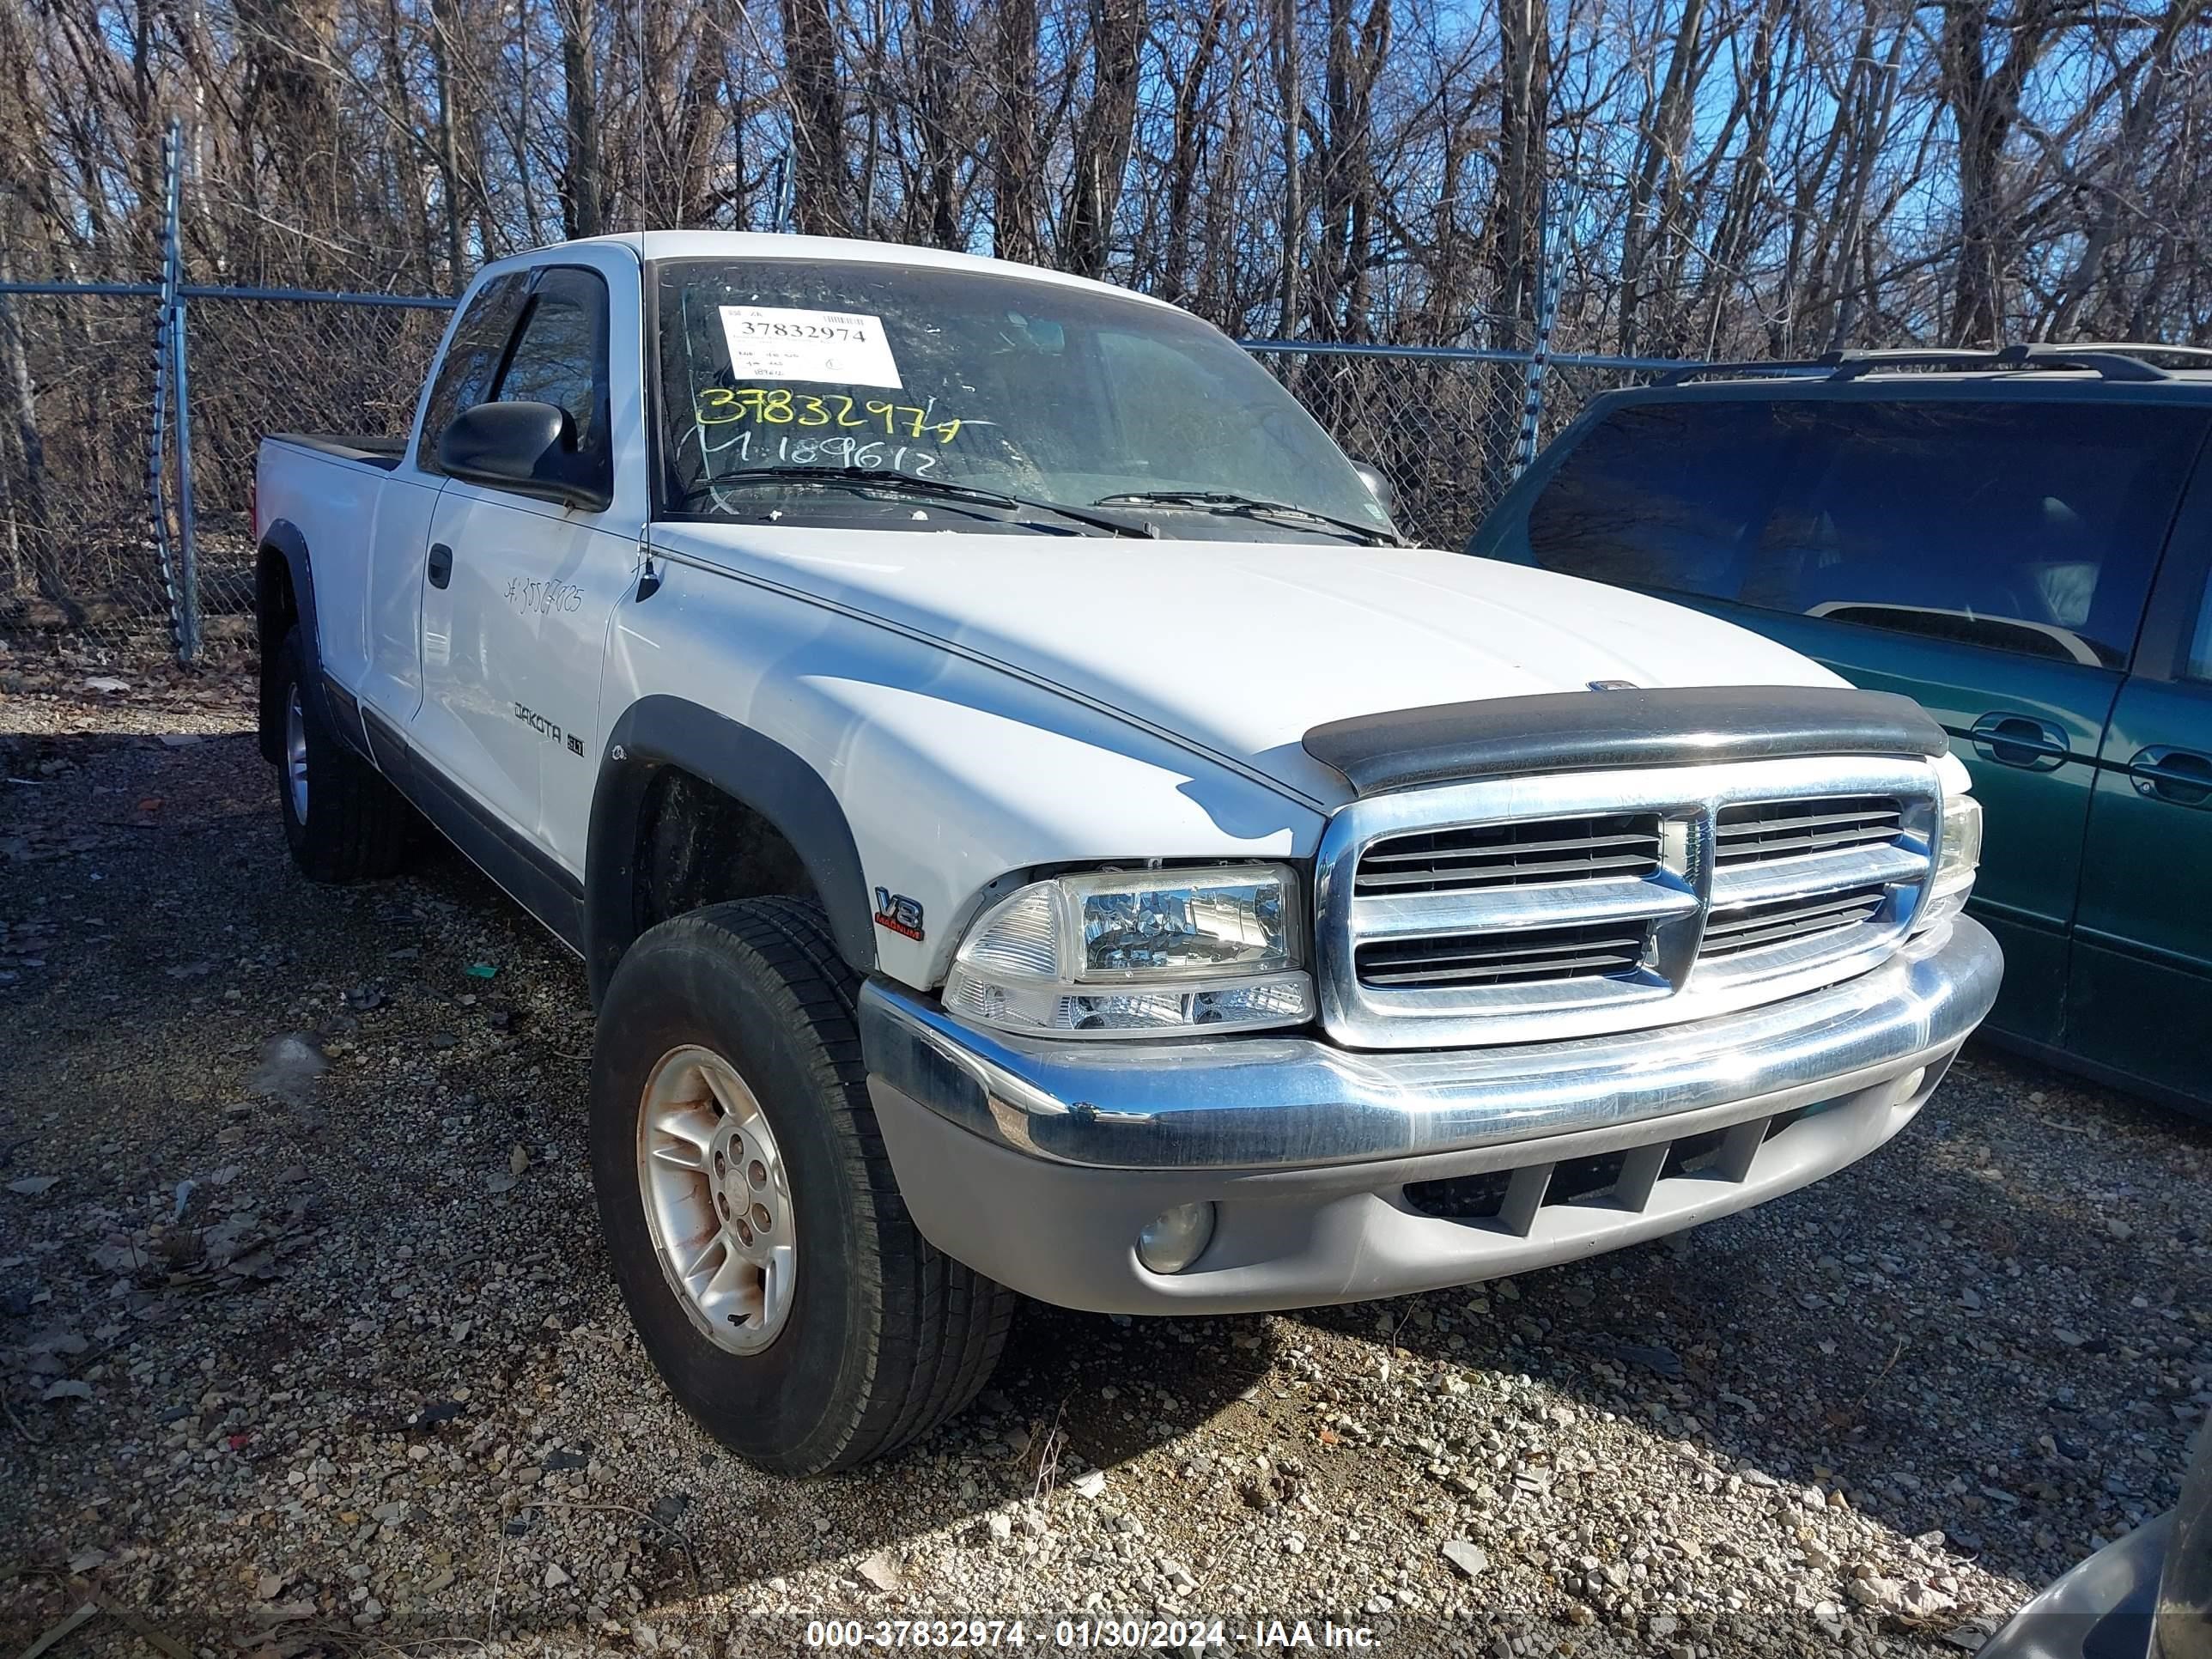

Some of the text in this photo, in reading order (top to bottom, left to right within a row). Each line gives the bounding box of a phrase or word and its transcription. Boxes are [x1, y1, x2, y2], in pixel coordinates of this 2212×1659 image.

[741, 321, 866, 343] 37832974
[514, 702, 562, 744] DAKOTA
[875, 886, 924, 930] V8
[875, 913, 922, 940] MAGNUM
